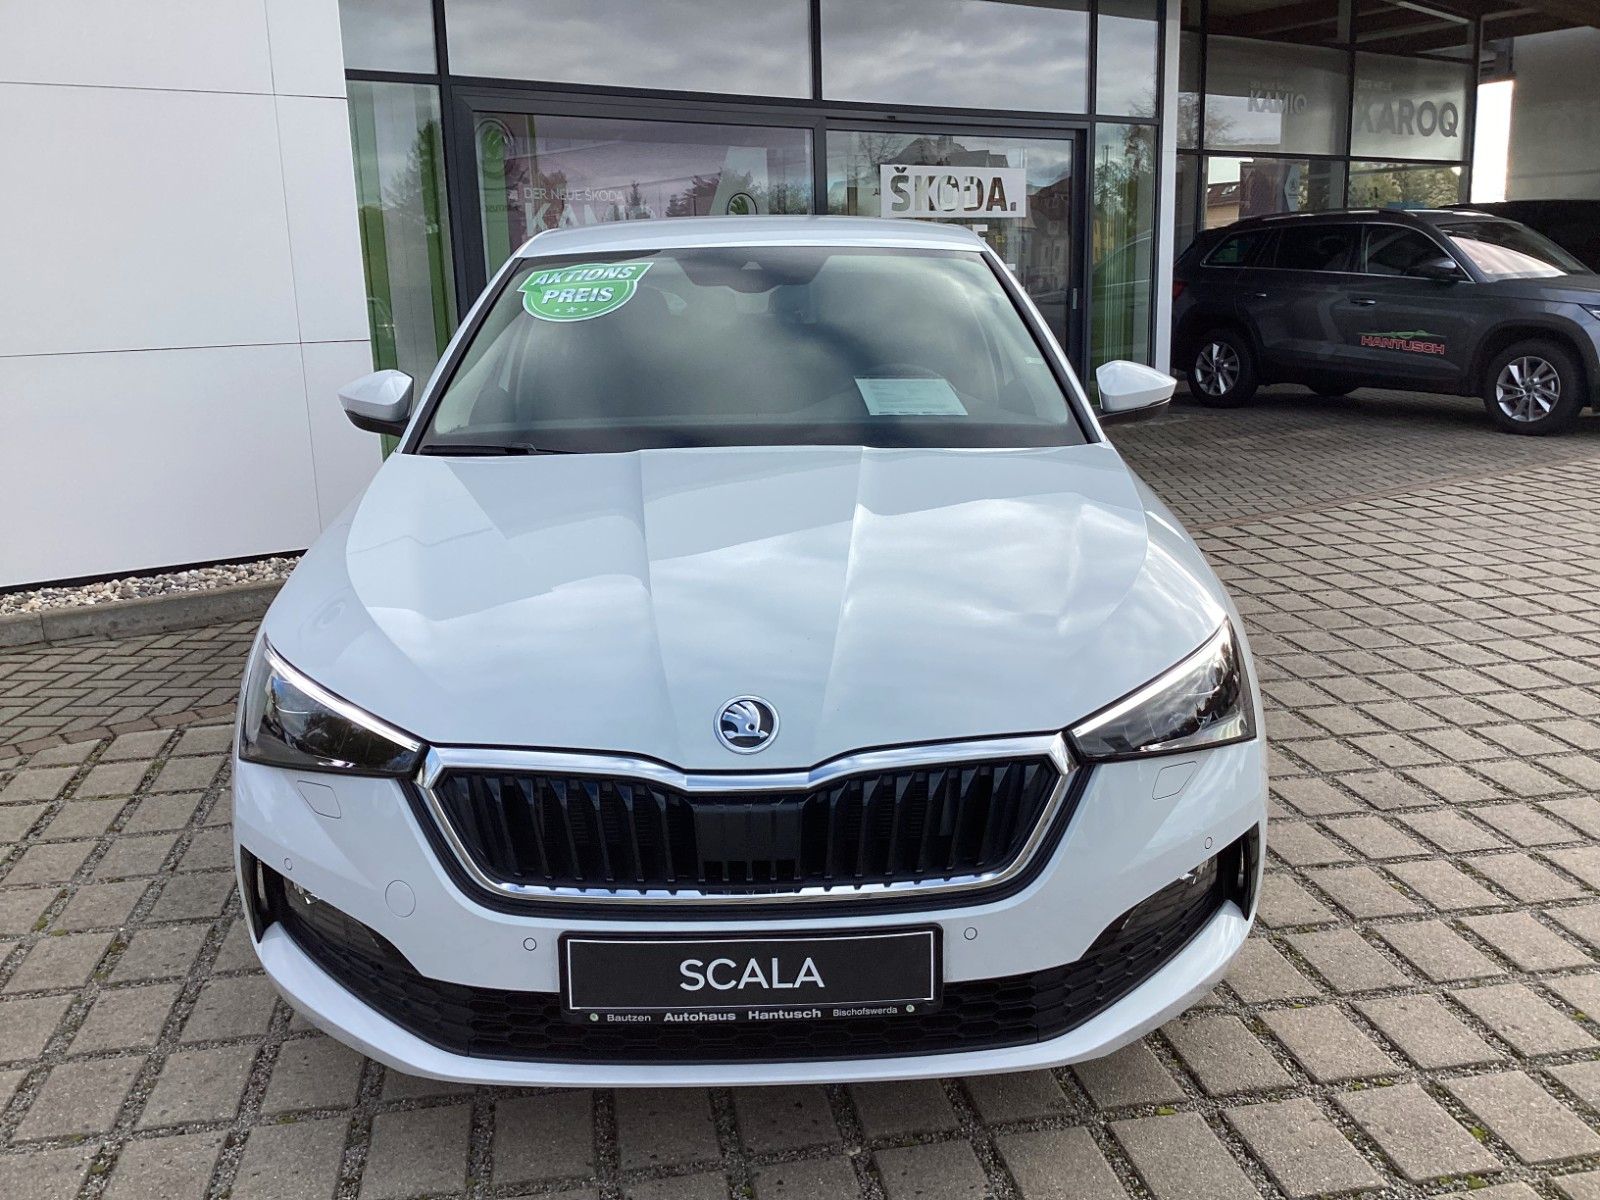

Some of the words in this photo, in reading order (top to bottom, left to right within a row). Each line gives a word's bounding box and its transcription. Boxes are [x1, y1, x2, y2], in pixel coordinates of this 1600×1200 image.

[1354, 99, 1459, 138] KAROQ
[524, 187, 547, 200] DER
[525, 203, 657, 238] KAM
[530, 266, 637, 286] AKTIONS
[541, 287, 615, 304] PREIS
[1360, 335, 1445, 355] HANTUSCH
[679, 957, 825, 991] SCALA
[606, 1013, 651, 1022] Bautzen
[663, 1011, 736, 1022] Autohaus
[748, 1008, 822, 1020] Hantusch
[832, 1006, 898, 1017] Bischofswerda
